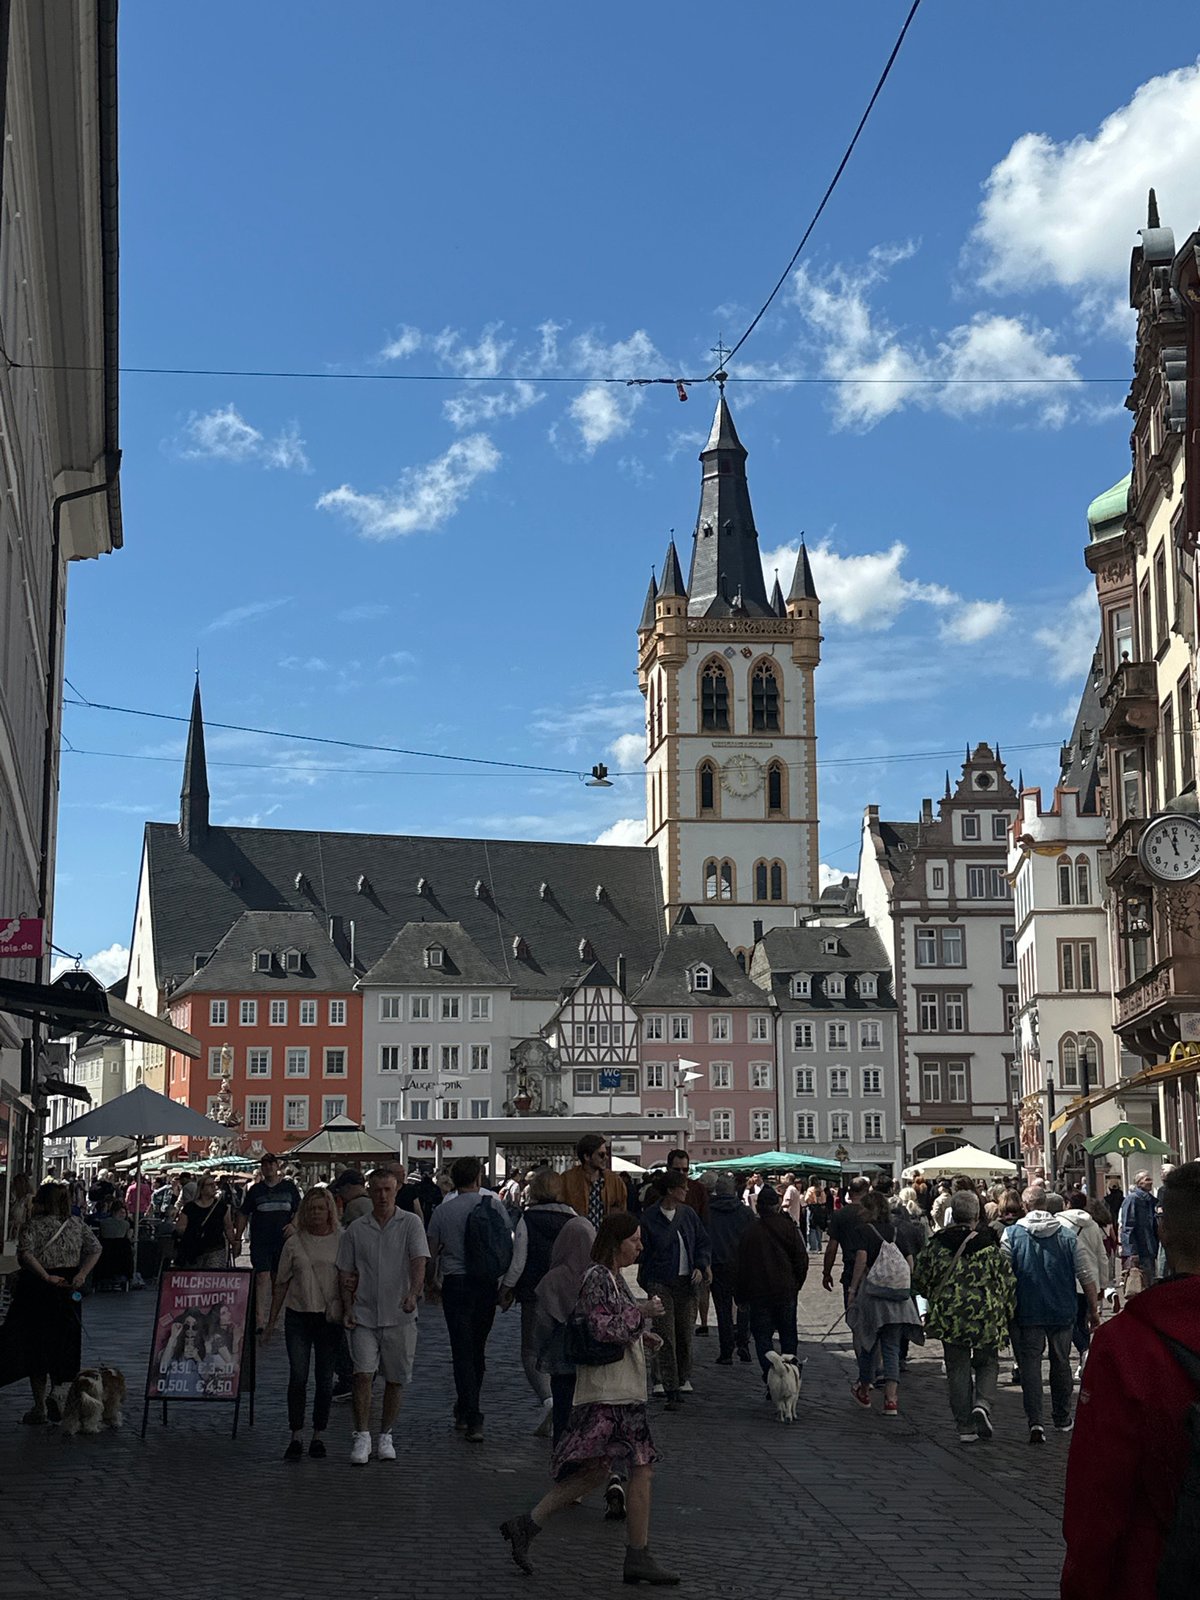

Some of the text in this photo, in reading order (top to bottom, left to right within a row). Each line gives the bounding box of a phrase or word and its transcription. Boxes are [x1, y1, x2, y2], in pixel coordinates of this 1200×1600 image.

[1190, 834, 1195, 842] 2
[1152, 846, 1157, 854] 9
[1194, 844, 1200, 852] 3
[1155, 856, 1161, 864] 8
[1191, 854, 1196, 862] 4
[603, 1068, 620, 1077] WC
[171, 1276, 241, 1289] MILCHSHAKE
[174, 1292, 235, 1308] MITTWOCH
[160, 1361, 192, 1375] 0,33L
[157, 1380, 189, 1394] 0,50L
